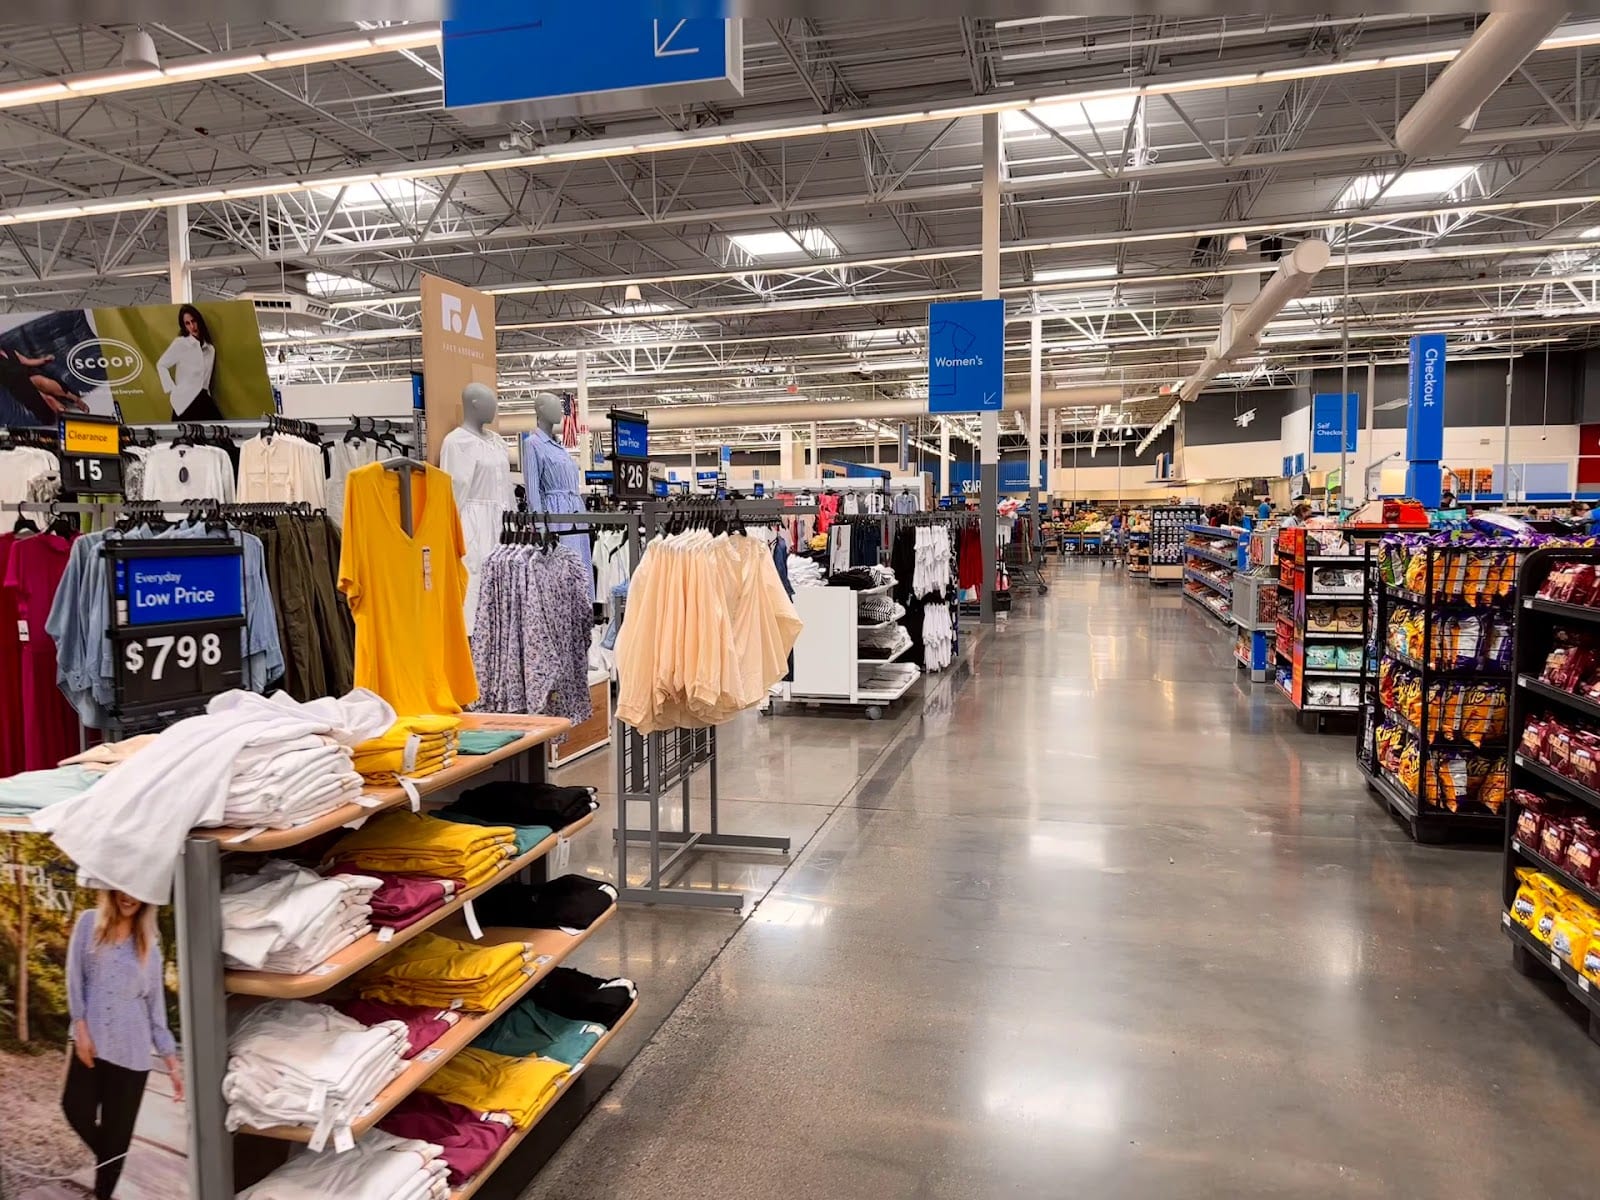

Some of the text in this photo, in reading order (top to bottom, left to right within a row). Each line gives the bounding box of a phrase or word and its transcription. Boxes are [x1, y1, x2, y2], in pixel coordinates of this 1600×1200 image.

[75, 355, 134, 370] SCOOP
[935, 355, 983, 368] Women's
[1424, 348, 1438, 407] Checkout
[68, 430, 108, 442] Clearance
[628, 437, 640, 449] Price
[75, 458, 103, 481] 15
[135, 571, 182, 584] Everyday
[135, 586, 216, 608] Low Price
